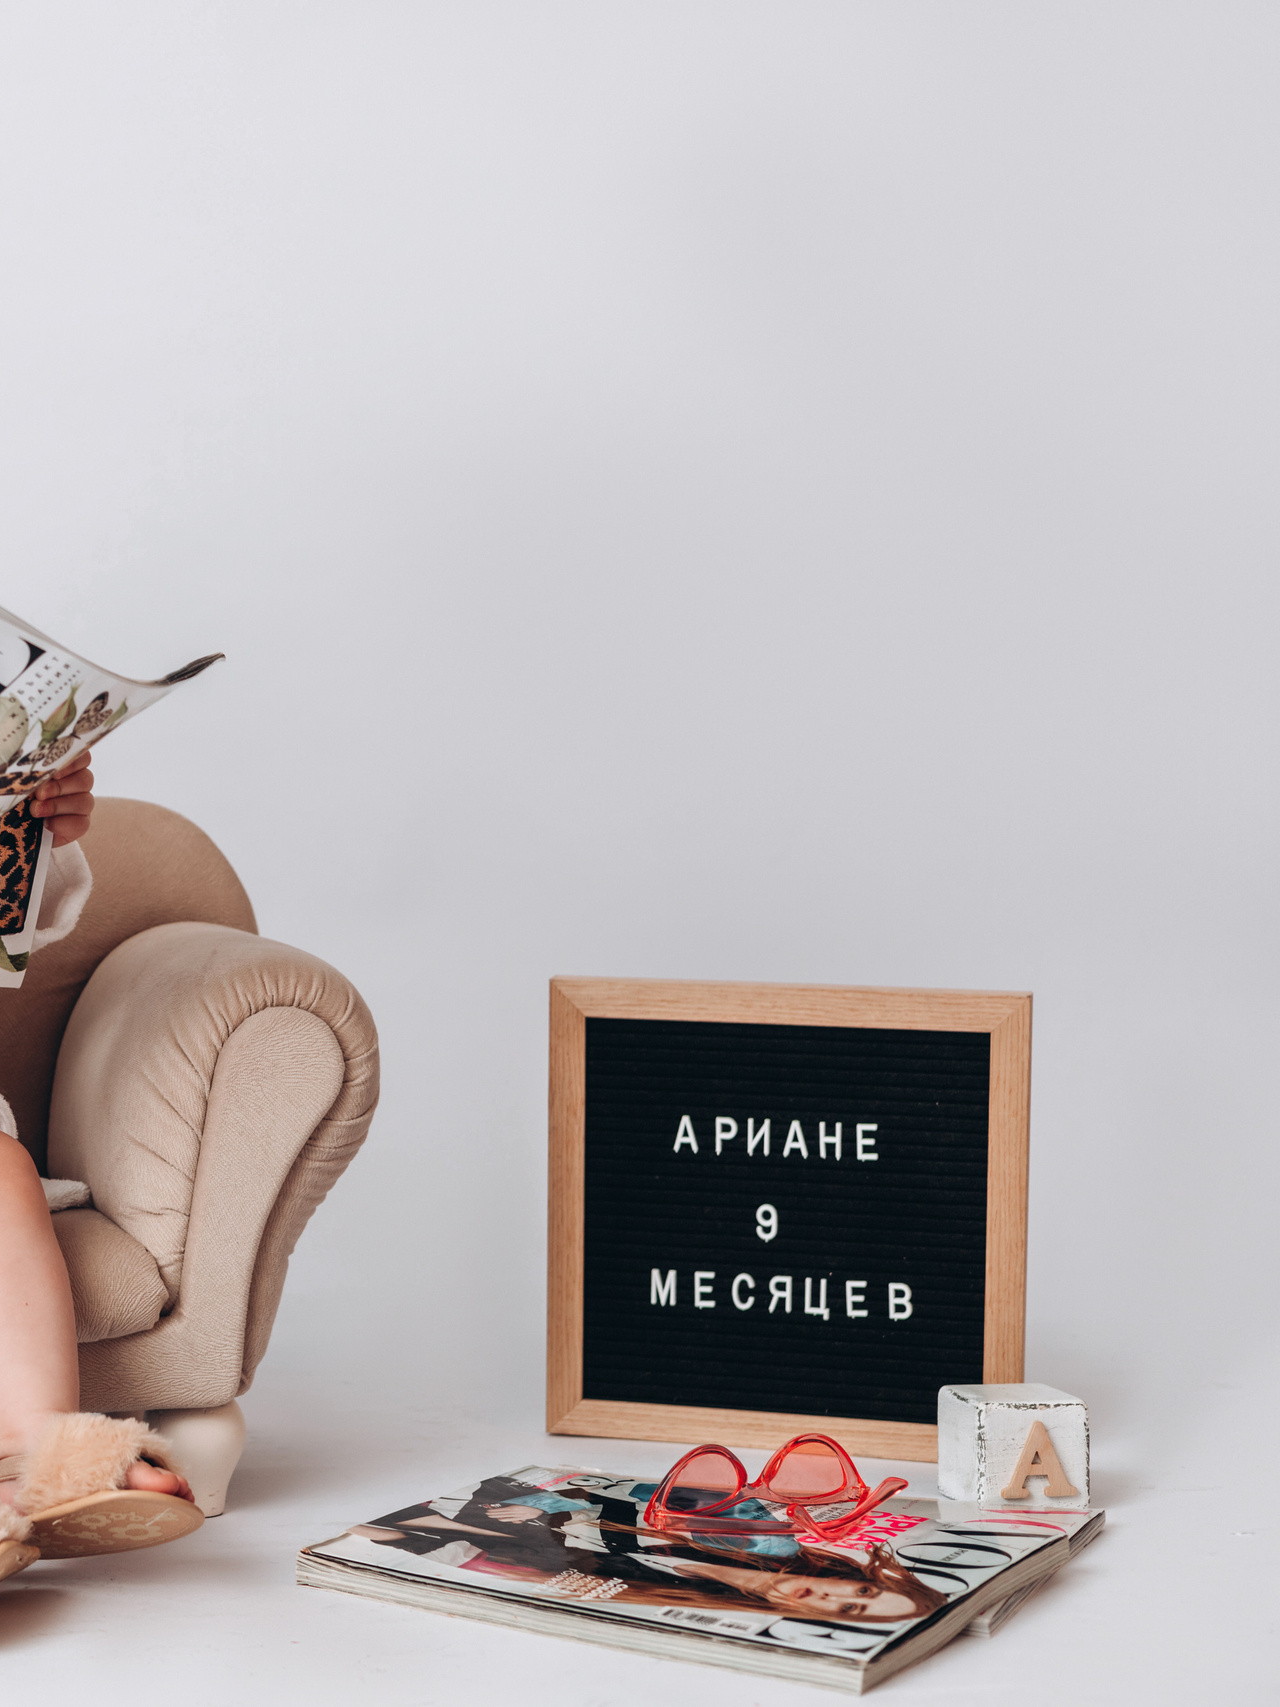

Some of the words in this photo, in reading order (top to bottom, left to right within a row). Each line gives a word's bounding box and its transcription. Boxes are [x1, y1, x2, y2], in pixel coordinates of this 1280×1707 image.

[8, 656, 60, 703] ОБЪЕКТ
[9, 663, 71, 720] ЖЕЛАНИЯ
[673, 1114, 880, 1162] АРИАНЕ
[755, 1203, 779, 1243] 9
[650, 1268, 914, 1321] МЕСЯЦЕВ
[832, 1514, 930, 1551] ЯРКАЯ
